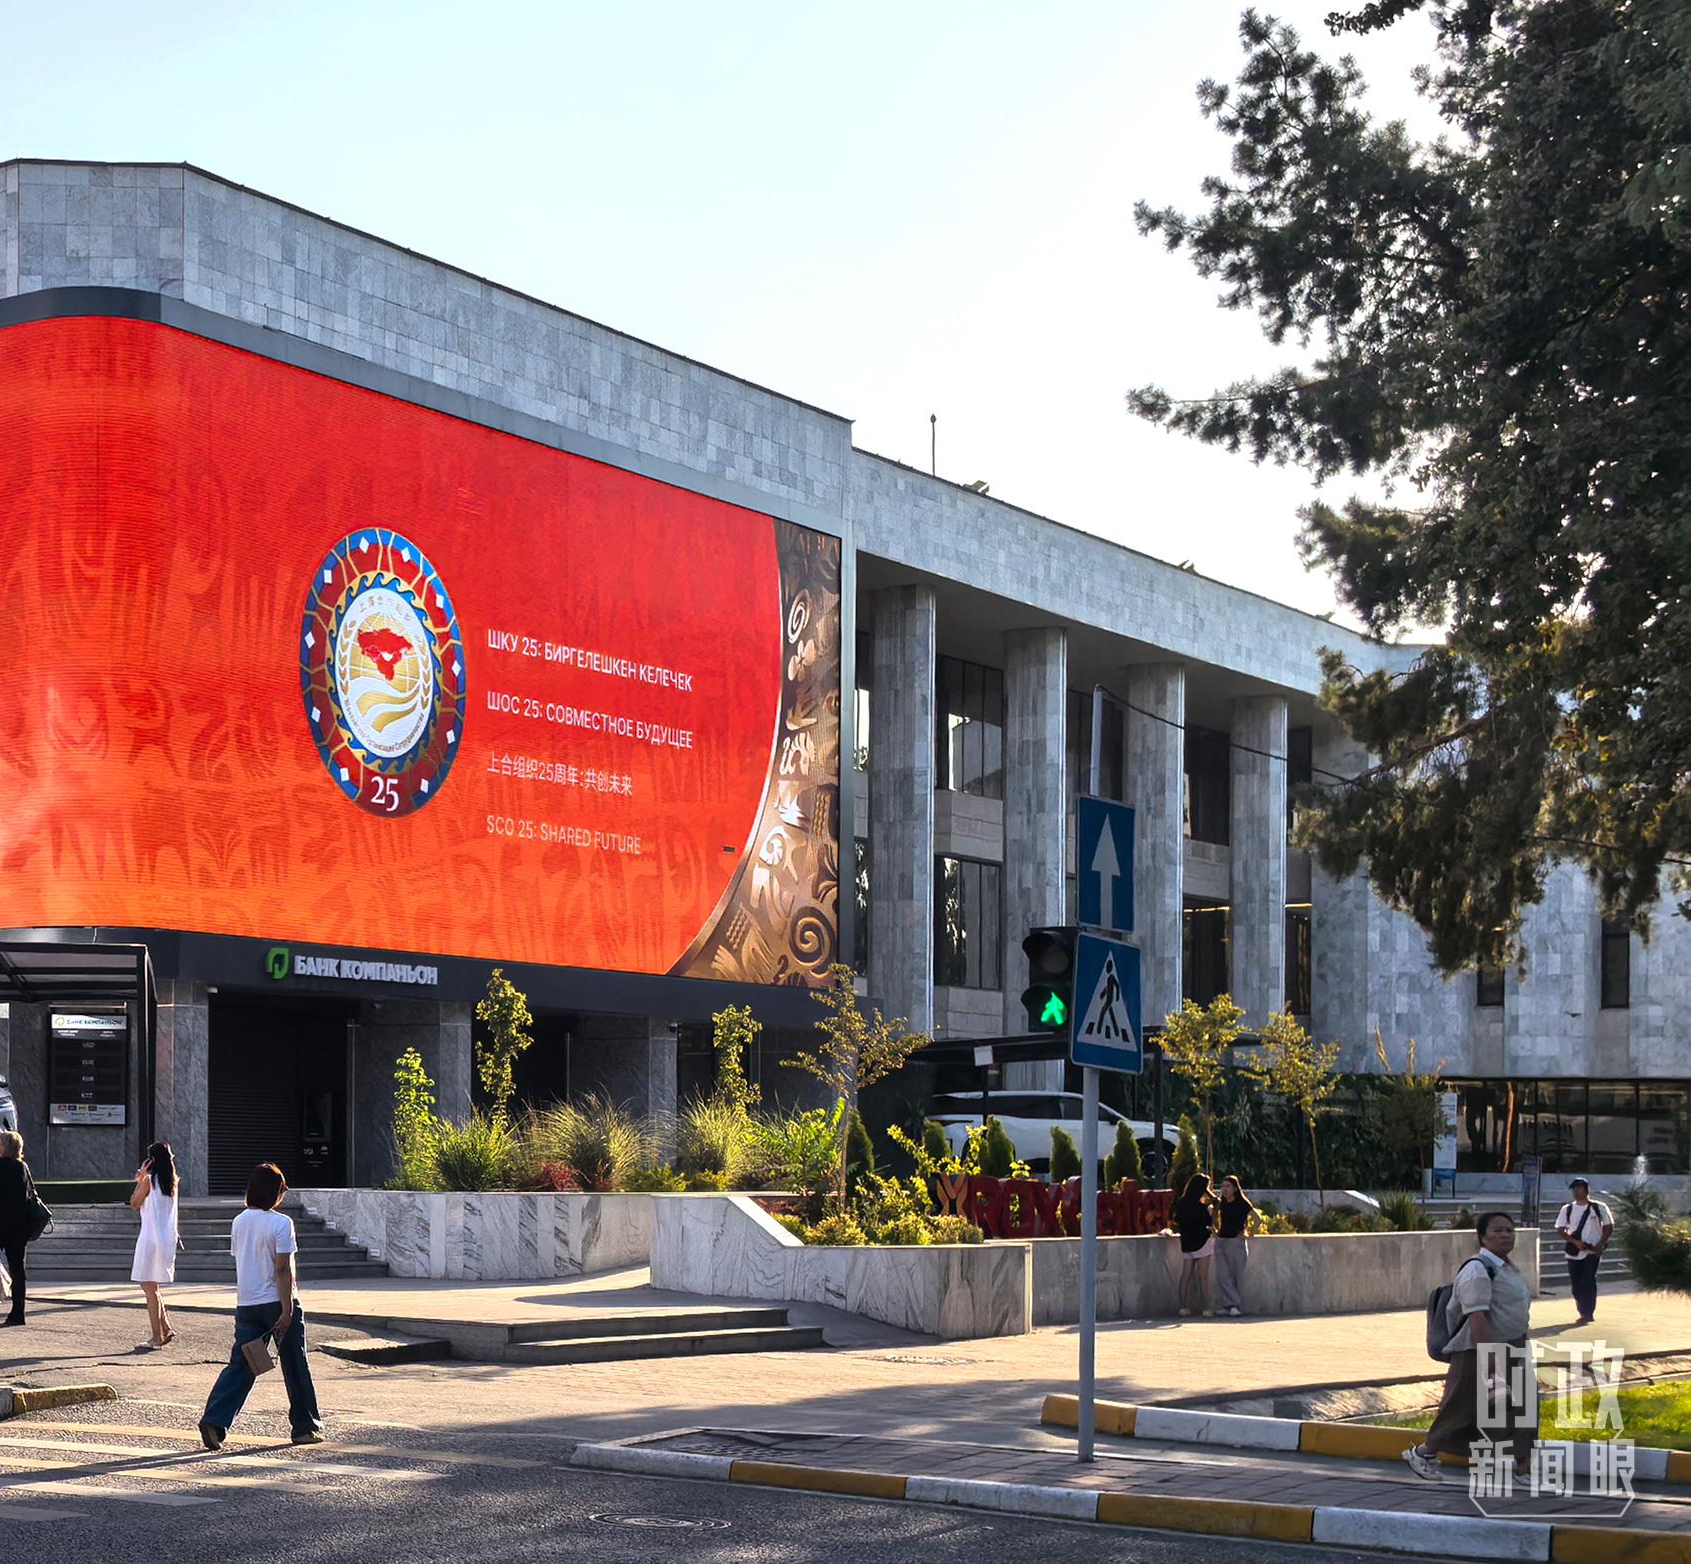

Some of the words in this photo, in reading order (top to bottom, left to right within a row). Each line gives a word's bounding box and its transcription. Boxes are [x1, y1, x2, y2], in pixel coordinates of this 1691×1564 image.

[487, 629, 518, 653] ШКУ
[522, 636, 542, 657] 25:
[544, 642, 637, 679] БИРГЕЛЕШКЕН
[639, 663, 693, 692] КЕЛЕЧЕК
[487, 690, 520, 715] ШОС
[523, 698, 543, 719] 25:
[546, 703, 633, 737] СОВМЕСТНОЕ
[636, 721, 693, 749] БУДУЩЕЕ
[370, 776, 399, 812] 25
[486, 815, 514, 836] SCO
[518, 820, 537, 839] 25:
[540, 823, 591, 847] SHARED
[595, 831, 641, 855] FUTURE
[294, 955, 339, 978] БАНК
[340, 959, 438, 985] КОМПАНЬОН
